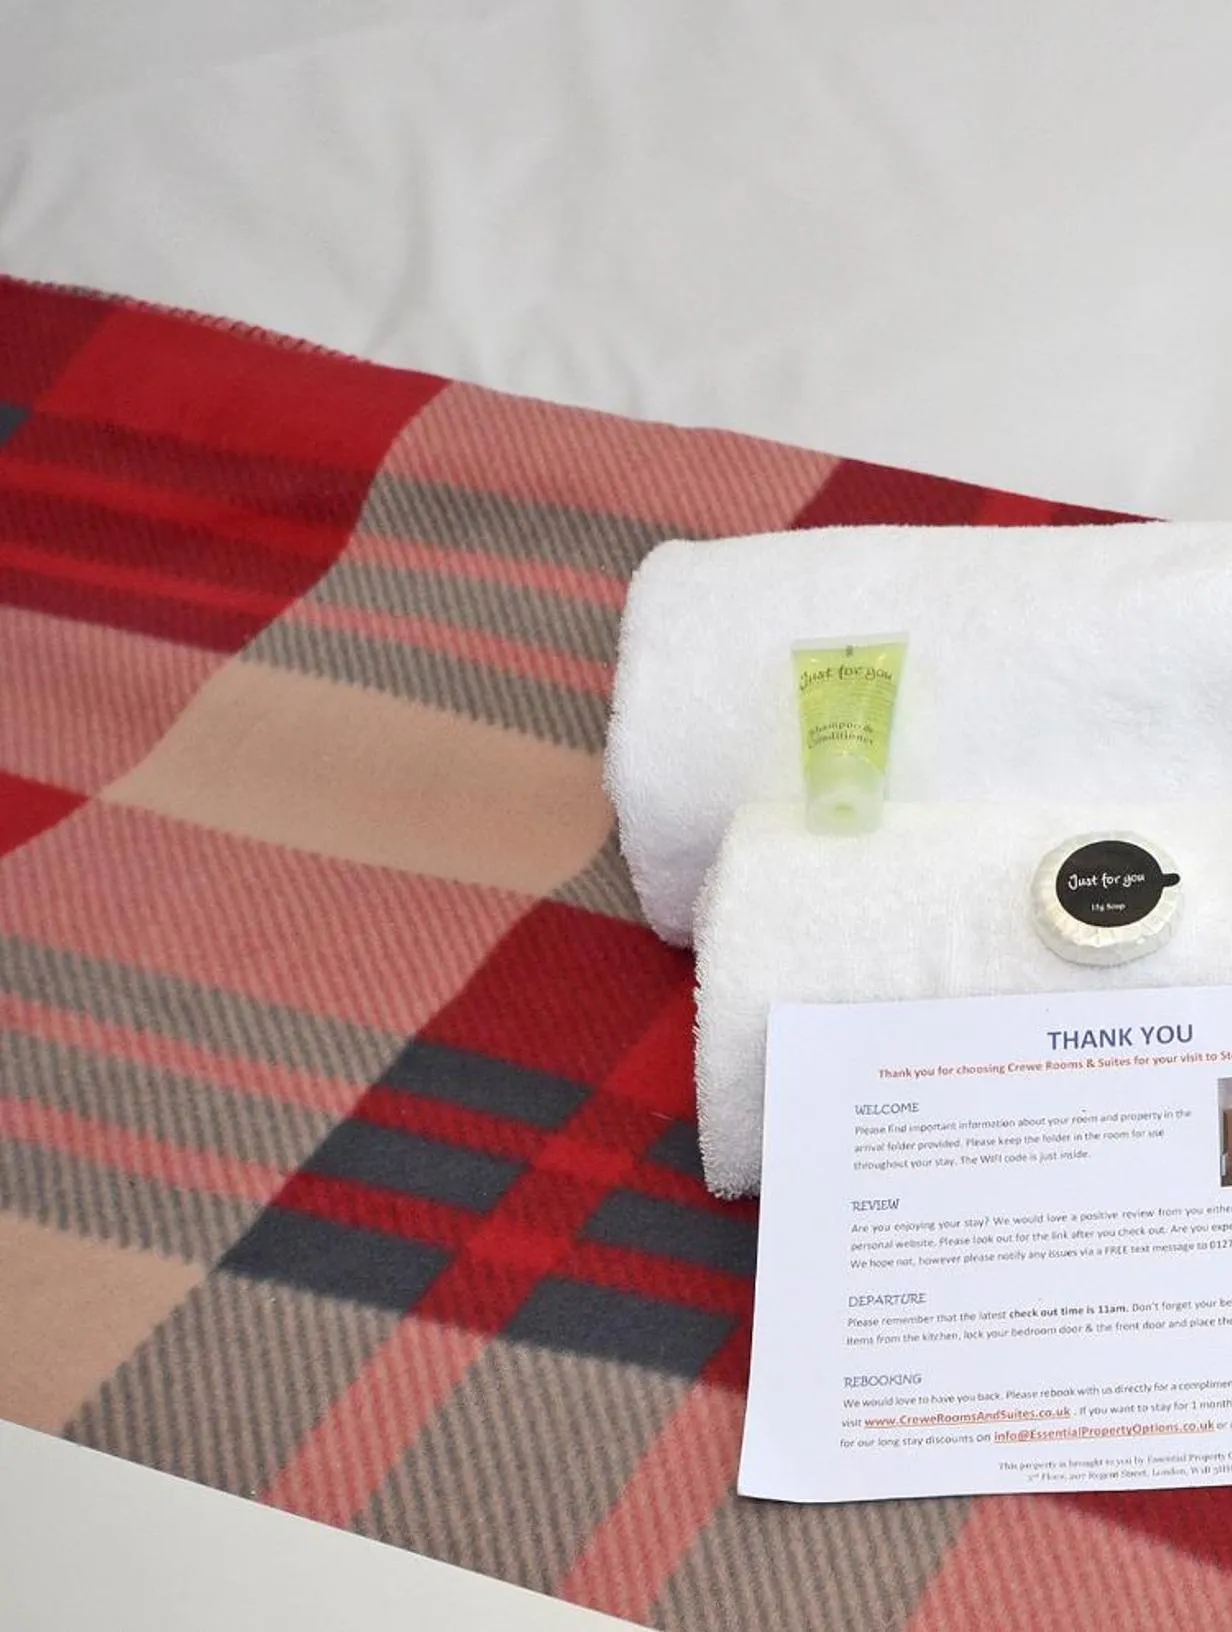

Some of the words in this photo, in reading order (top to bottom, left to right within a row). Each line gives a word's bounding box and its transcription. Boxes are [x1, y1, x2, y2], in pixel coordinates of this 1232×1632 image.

[800, 666, 833, 691] Just
[838, 665, 864, 680] for
[865, 668, 893, 681] you
[1068, 873, 1098, 891] Just
[1101, 872, 1121, 889] for
[1122, 873, 1145, 888] you
[1046, 1027, 1132, 1051] THANK
[1140, 1023, 1192, 1046] YOU
[879, 1067, 911, 1078] Thank
[914, 1068, 934, 1079] you
[938, 1066, 953, 1075] for
[956, 1064, 1005, 1075] choosing
[1007, 1063, 1041, 1072] Crewe
[1045, 1061, 1083, 1070] Rooms
[1086, 1059, 1095, 1068] &
[1098, 1058, 1129, 1068] Suites
[1134, 1057, 1149, 1066] for
[1152, 1056, 1176, 1067] your
[1180, 1053, 1202, 1063] visit
[1205, 1053, 1217, 1062] to
[854, 1101, 919, 1116] WELCOME
[854, 1125, 885, 1135] Please
[888, 1123, 906, 1133] find
[958, 1118, 1015, 1129] information
[1017, 1116, 1046, 1126] about
[1047, 1117, 1068, 1127] your
[1071, 1115, 1097, 1124] room
[1100, 1112, 1118, 1122] and
[1120, 1111, 1161, 1124] property
[1174, 1109, 1191, 1118] the
[966, 1137, 996, 1147] Please
[1023, 1134, 1040, 1144] the
[1084, 1132, 1100, 1141] the
[1103, 1132, 1129, 1140] room
[852, 1159, 908, 1171] throughout
[910, 1159, 932, 1169] your
[960, 1155, 977, 1165] The
[1004, 1153, 1027, 1163] code
[1039, 1152, 1056, 1163] just
[851, 1198, 900, 1212] REVIEW
[851, 1223, 868, 1233] Are
[872, 1223, 890, 1234] you
[938, 1220, 960, 1231] your
[964, 1216, 989, 1229] stay?
[992, 1216, 1009, 1225] We
[1013, 1214, 1043, 1224] would
[1122, 1209, 1153, 1219] review
[1185, 1207, 1203, 1218] you
[995, 1233, 1012, 1243] out
[1032, 1231, 1048, 1241] the
[1096, 1230, 1115, 1240] you
[1170, 1224, 1187, 1234] Are
[1190, 1225, 1209, 1235] you
[850, 1259, 867, 1268] We
[918, 1255, 961, 1265] however
[963, 1253, 994, 1265] please
[1028, 1251, 1045, 1261] any
[848, 1292, 927, 1307] DEPARTURE
[847, 1317, 878, 1327] Please
[959, 1311, 976, 1321] the
[1009, 1308, 1038, 1318] check
[1040, 1307, 1057, 1317] out
[1060, 1306, 1083, 1316] time
[1086, 1305, 1094, 1314] is
[1098, 1304, 1129, 1314] 11am.
[1161, 1300, 1192, 1312] forget
[1194, 1300, 1216, 1311] your
[986, 1330, 1008, 1341] your
[1058, 1325, 1081, 1335] door
[1115, 1322, 1139, 1332] front
[1142, 1321, 1165, 1330] door
[1168, 1319, 1187, 1329] and
[844, 1372, 922, 1388] REBOOKING
[843, 1399, 860, 1409] We
[862, 1397, 893, 1408] would
[931, 1395, 954, 1404] have
[956, 1395, 975, 1405] you
[1005, 1391, 1038, 1400] Please
[1076, 1386, 1099, 1396] with
[1114, 1383, 1151, 1395] directly
[1154, 1383, 1168, 1392] for
[863, 1407, 1070, 1429] www.CreweRoomsAndSuites.co.uk
[1089, 1408, 1108, 1418] you
[1110, 1405, 1135, 1414] want
[1137, 1404, 1148, 1413] to
[1150, 1403, 1171, 1414] stay
[1173, 1402, 1188, 1411] for
[1199, 1399, 1232, 1410] month
[839, 1438, 854, 1448] for
[877, 1436, 899, 1448] long
[902, 1436, 922, 1447] stay
[925, 1433, 973, 1444] discounts
[992, 1421, 1215, 1443] info@EssentialPropertyOptions.co.uk
